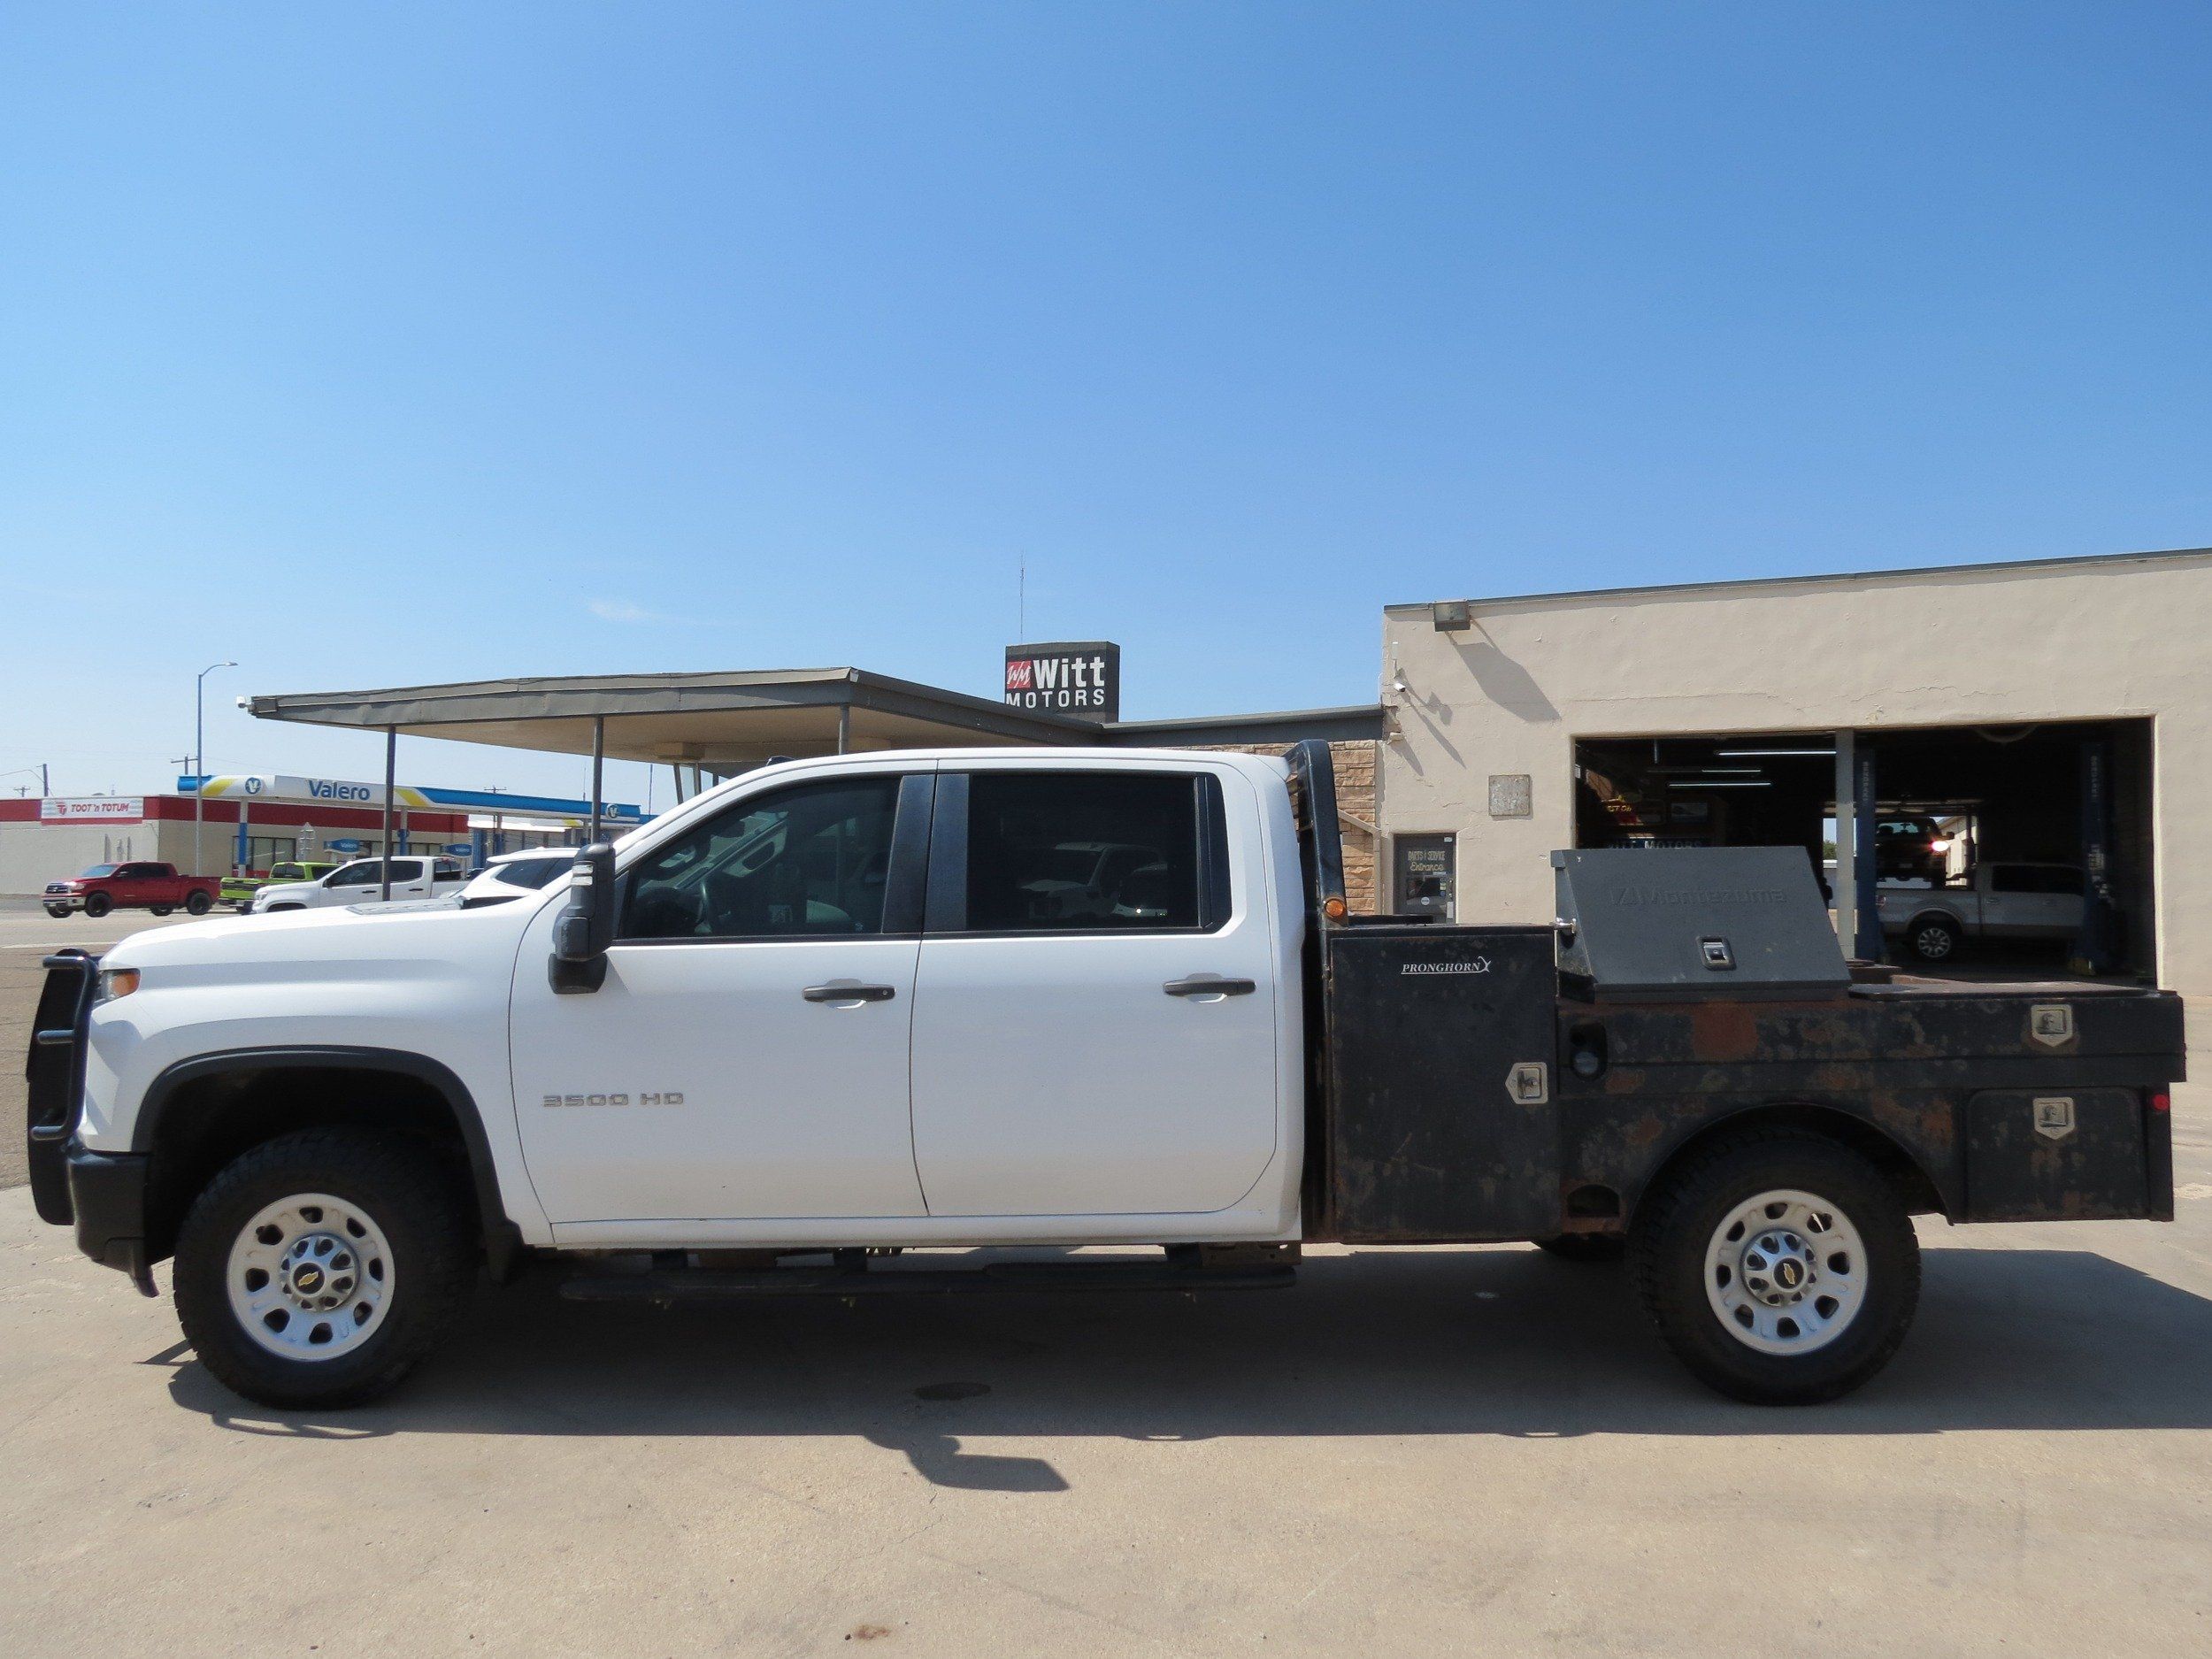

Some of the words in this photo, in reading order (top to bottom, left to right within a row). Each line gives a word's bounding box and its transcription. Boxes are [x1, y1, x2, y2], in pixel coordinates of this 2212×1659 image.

[1033, 657, 1105, 689] Witt
[1006, 688, 1105, 709] MOTORS
[308, 780, 371, 801] Valero
[71, 803, 92, 812] TOOT
[102, 803, 130, 812] TOTUM
[1409, 862, 1445, 872] Entrance
[1402, 962, 1481, 973] PRONGHORN
[542, 1094, 629, 1108] 3500
[640, 1092, 684, 1106] HD
